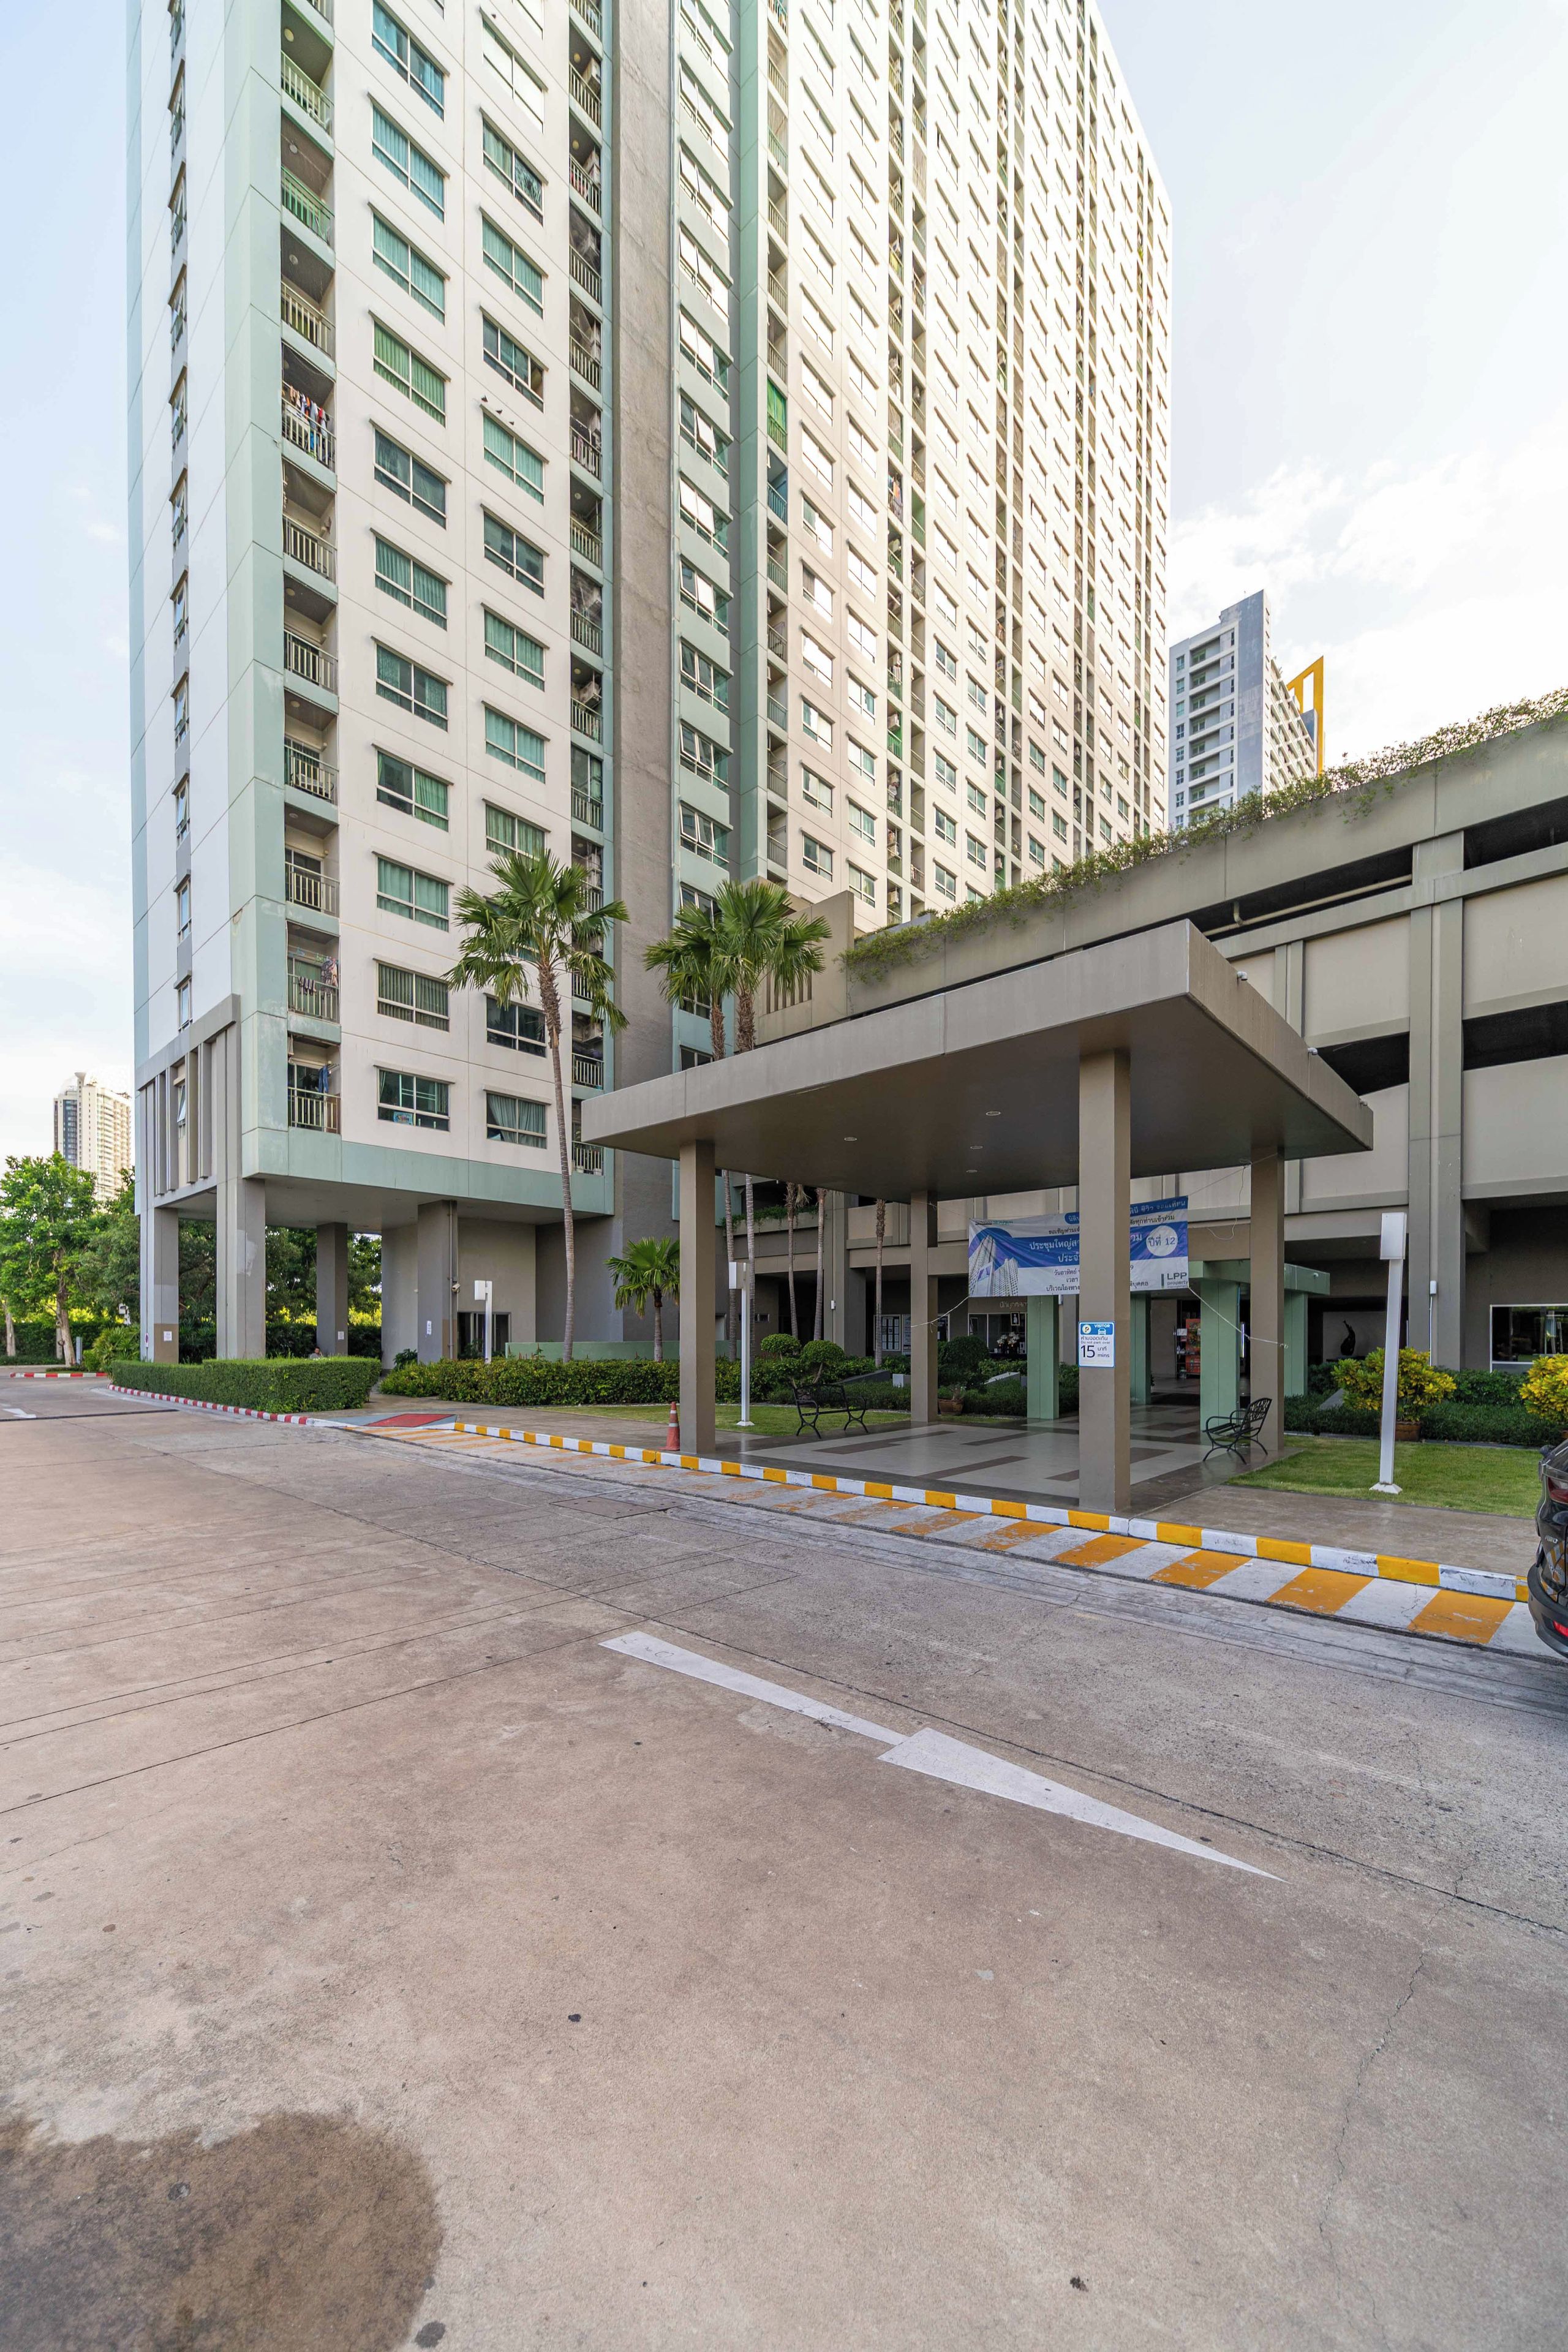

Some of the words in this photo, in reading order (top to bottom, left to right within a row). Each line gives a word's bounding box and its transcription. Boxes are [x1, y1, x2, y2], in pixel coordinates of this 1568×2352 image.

[1148, 1234, 1161, 1246] ปีที่
[1054, 1268, 1077, 1276] วันอาทิตย์
[1081, 1345, 1095, 1358] 15
